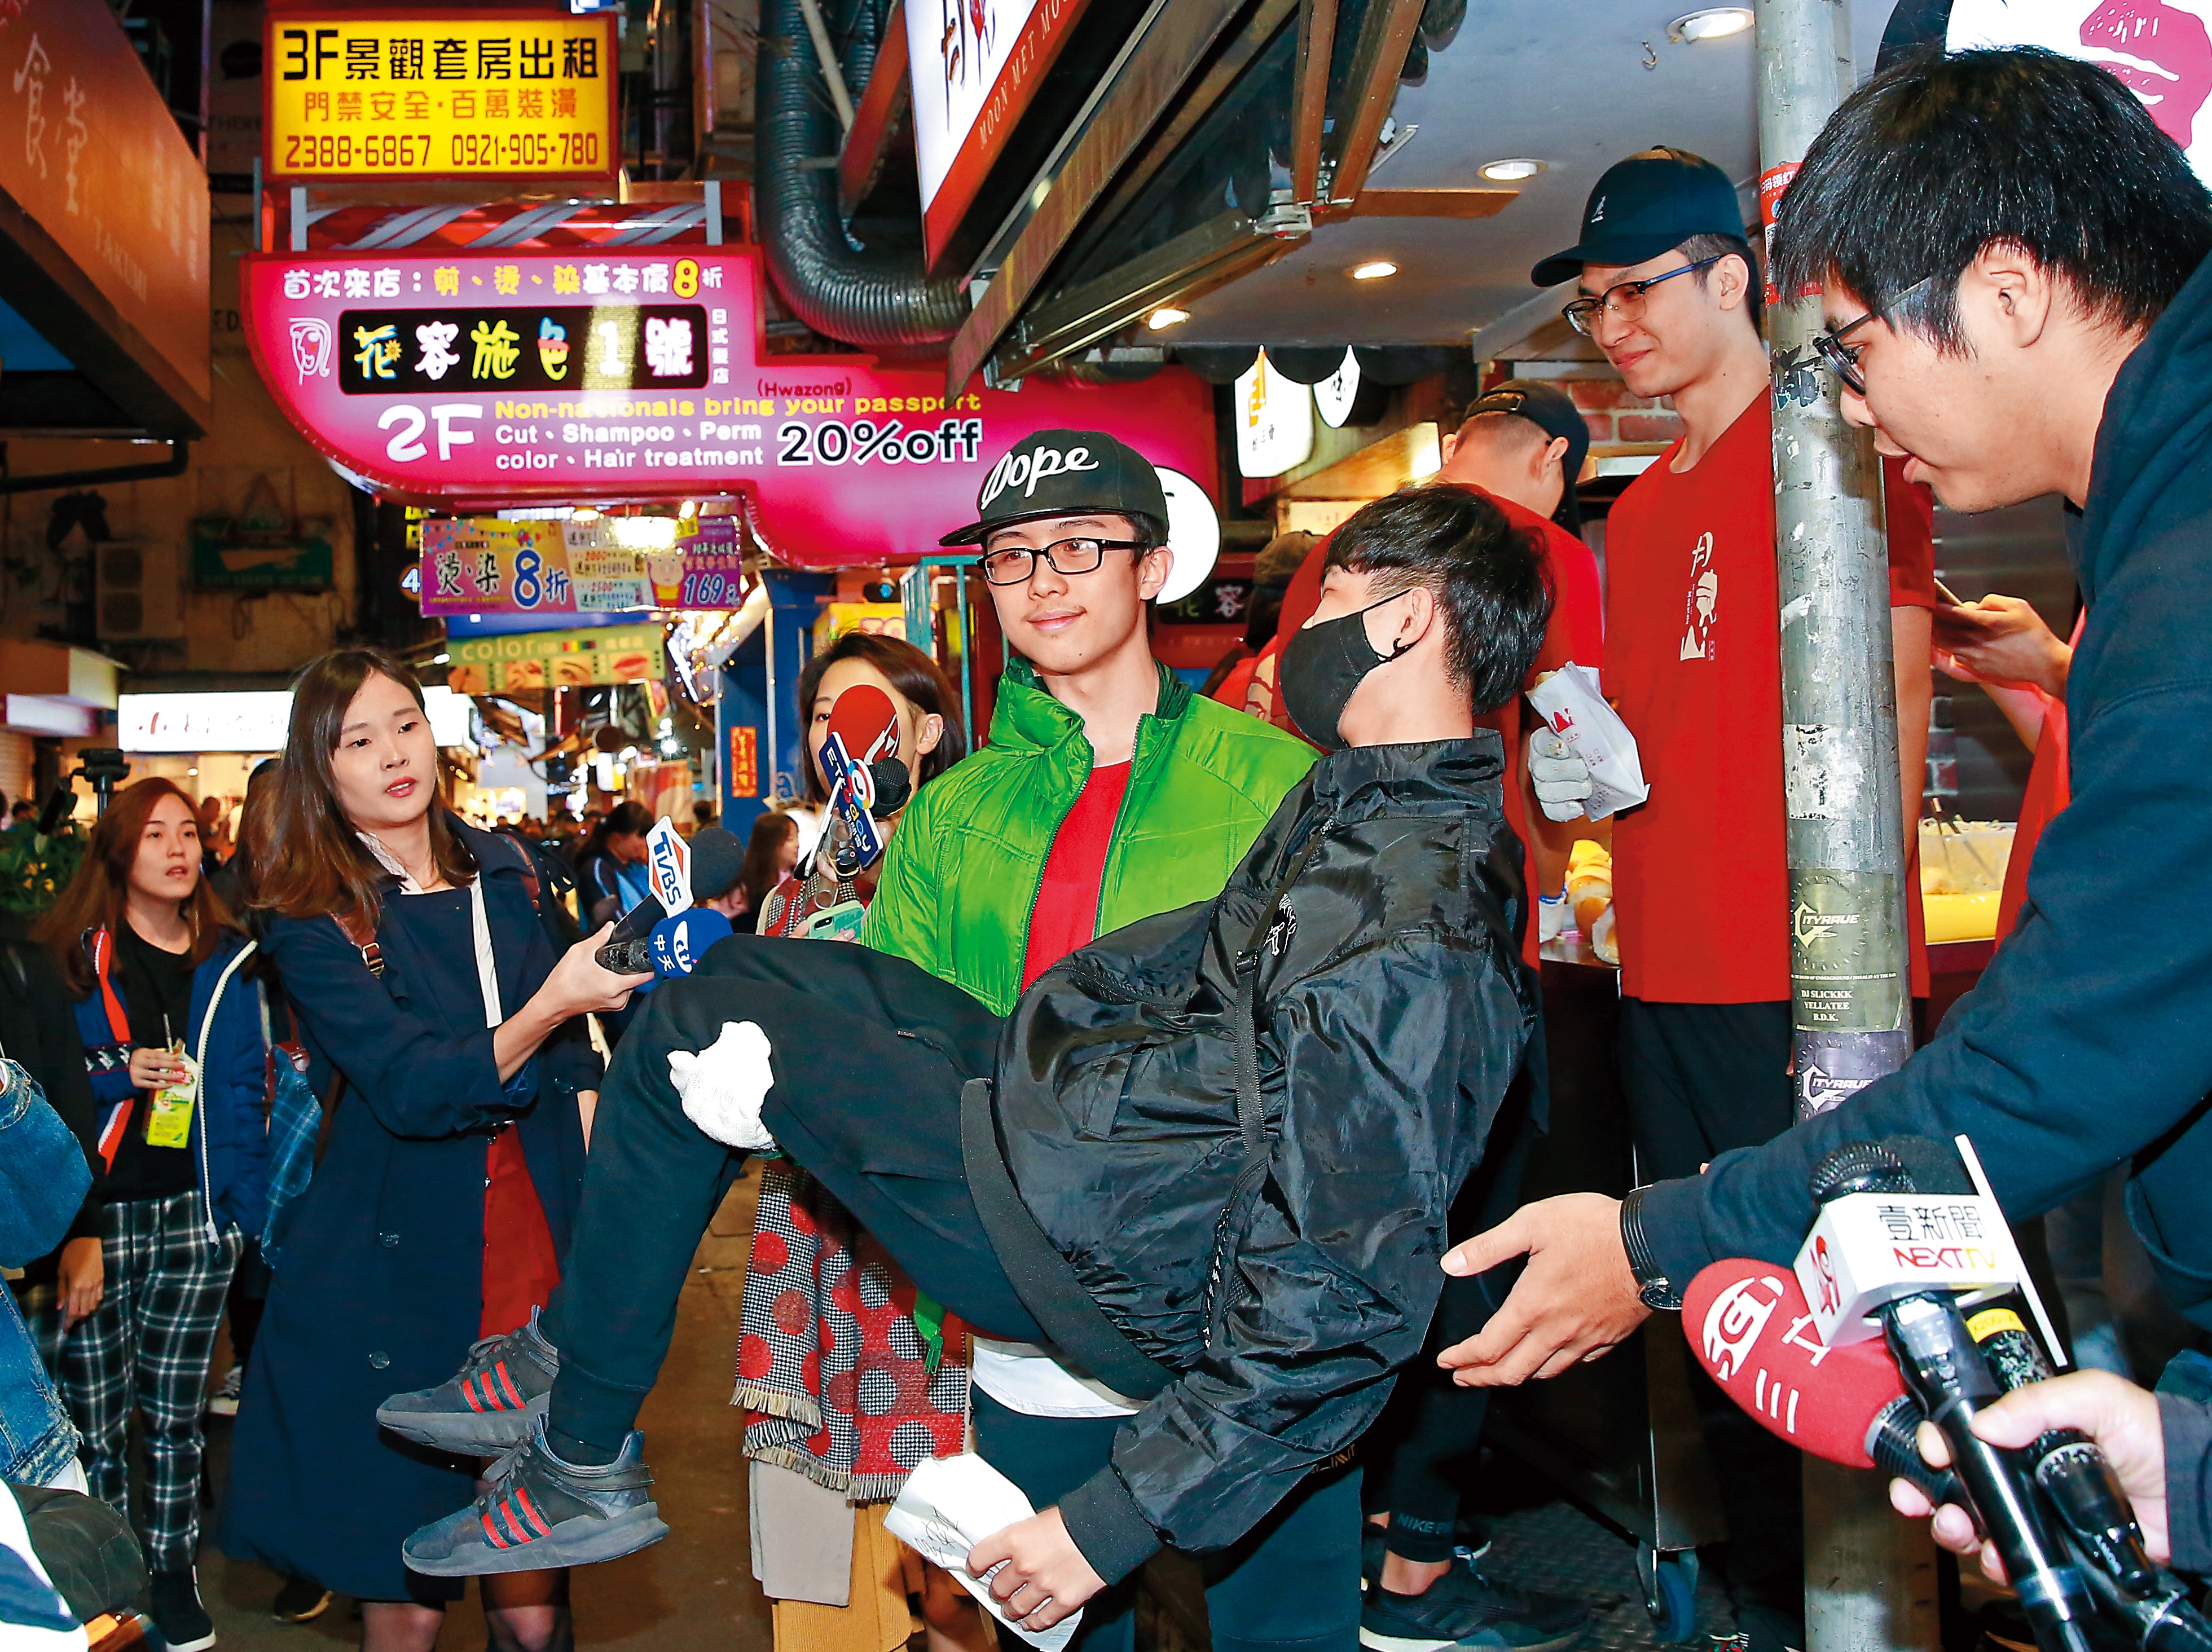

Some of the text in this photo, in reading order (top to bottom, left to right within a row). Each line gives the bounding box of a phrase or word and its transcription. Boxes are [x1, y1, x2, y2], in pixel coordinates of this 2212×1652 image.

[1041, 0, 1068, 39] MO
[283, 29, 599, 81] 3F景觀套房出租
[704, 397, 775, 417] bring
[785, 397, 845, 416] your
[376, 403, 483, 462] 2F
[700, 421, 762, 441] Perm
[584, 448, 637, 468] Hair
[645, 447, 764, 467] treatment
[980, 445, 1100, 510] Dope
[654, 831, 681, 906] TVBS
[654, 934, 675, 972] 中天
[1801, 990, 1853, 999] DJ SLICKKK
[1804, 1001, 1850, 1011] YELLATEE
[1813, 1013, 1839, 1022] B.D.K.
[1876, 1205, 1988, 1241] 壹新聞
[1397, 1513, 1435, 1533] NIKE
